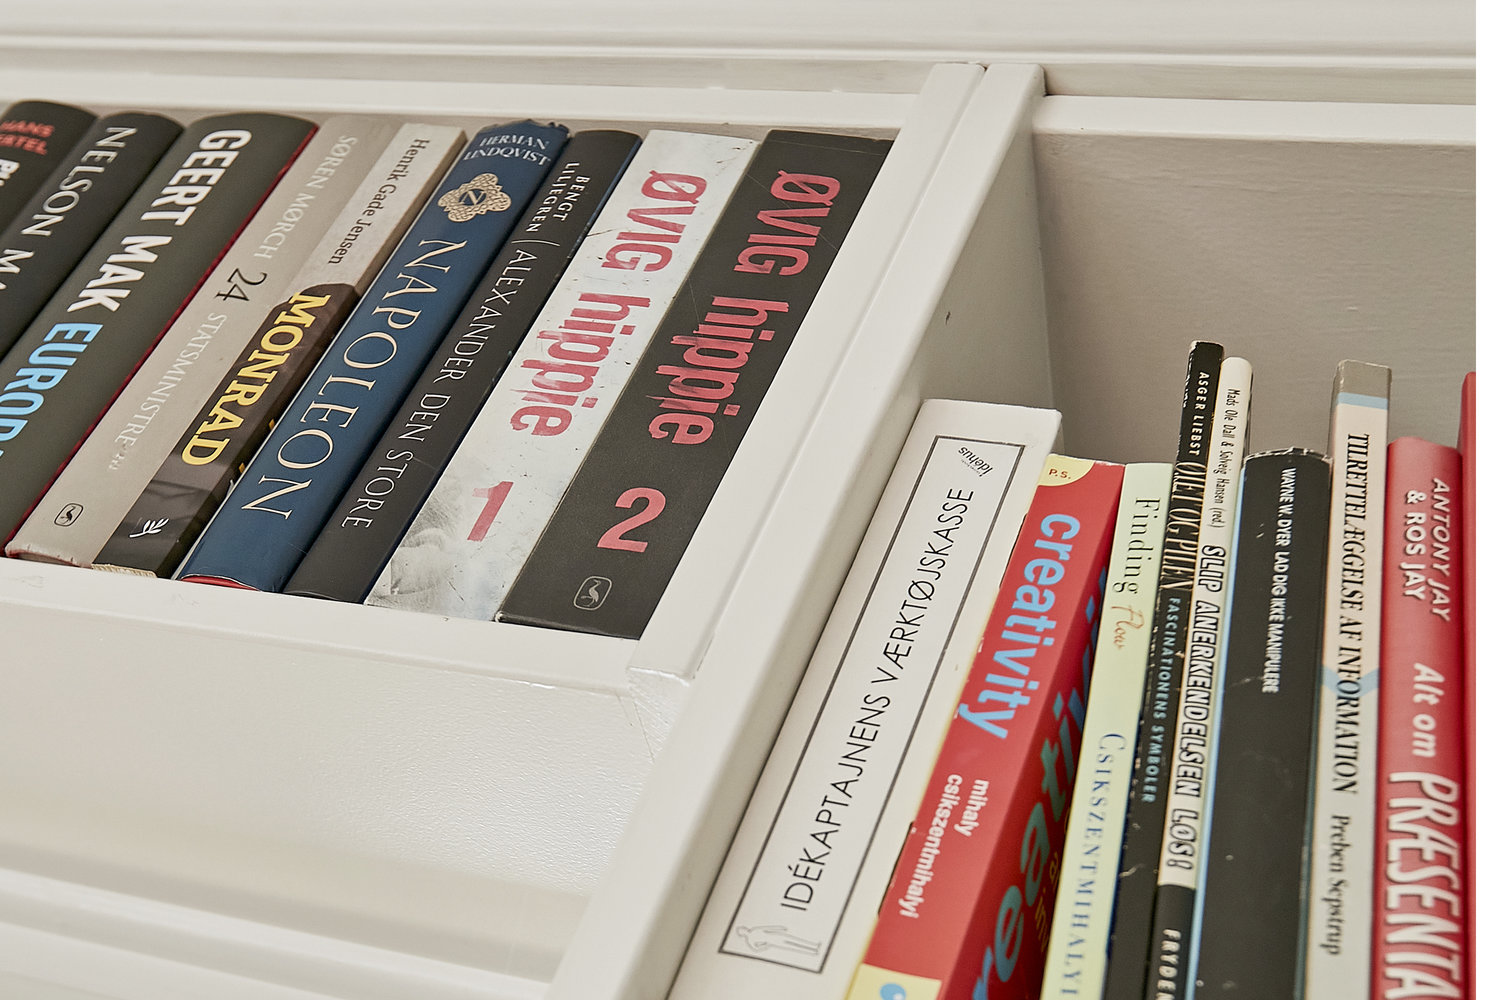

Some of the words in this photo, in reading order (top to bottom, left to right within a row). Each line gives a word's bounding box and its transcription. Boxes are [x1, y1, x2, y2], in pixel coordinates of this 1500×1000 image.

[306, 134, 358, 194] SØREN
[384, 138, 430, 184] Henrik
[463, 147, 551, 166] LINDQVIST
[480, 134, 550, 150] HERMAN
[20, 126, 138, 237] NELSON
[141, 128, 252, 227] GEERT
[361, 181, 398, 218] Gade
[553, 176, 590, 221] BENGT
[254, 193, 310, 258] MØRCH
[327, 213, 374, 265] Jensen
[602, 170, 706, 272] ØVIG
[734, 170, 840, 276] ØVIG
[66, 234, 172, 313] MAK
[217, 267, 268, 303] 24
[434, 247, 538, 383] ALEXANDER
[182, 293, 331, 465] MONRAD
[240, 239, 468, 519] NAPOLEON
[509, 293, 651, 436] hippie
[646, 296, 789, 445] hippie
[1195, 371, 1210, 410] ASGER
[398, 393, 451, 442] DEN
[1189, 415, 1204, 456] LIEBST
[342, 449, 406, 528] STORE
[468, 481, 513, 541] 1
[1279, 467, 1295, 504] WAYNE
[596, 487, 666, 552] 2
[1112, 497, 1160, 595] Finding
[1276, 518, 1292, 546] DYER
[1340, 433, 1370, 613] TILRETTELÆGGELSE
[1404, 512, 1426, 556] ROS
[1431, 478, 1450, 576] ANTONY
[1198, 545, 1226, 592] SLIP
[1272, 573, 1288, 594] DIG
[1275, 552, 1290, 572] LAD
[1400, 563, 1426, 600] JAY
[956, 513, 1080, 738] creativity
[1269, 598, 1287, 620] IKKE
[1338, 615, 1361, 641] AF
[1427, 576, 1450, 622] JAY
[1153, 598, 1181, 719] FASCINATIONENS
[1262, 623, 1284, 693] MANIPULERE
[1413, 662, 1445, 705] Alt
[781, 692, 891, 912] IDÉKAPTAJNENS
[871, 488, 973, 688] VÆRKTØJSKASSE
[1175, 599, 1220, 798] ANERKENDELSEN
[1332, 643, 1361, 795] INFORMATION
[1141, 725, 1164, 802] SYMBOLER
[1412, 714, 1436, 758] om
[954, 779, 989, 836] mihaly
[899, 774, 963, 919] csikszentmihalyi
[1060, 733, 1127, 996] CSIKSZENTMIHALYI
[1331, 815, 1351, 874] Preben
